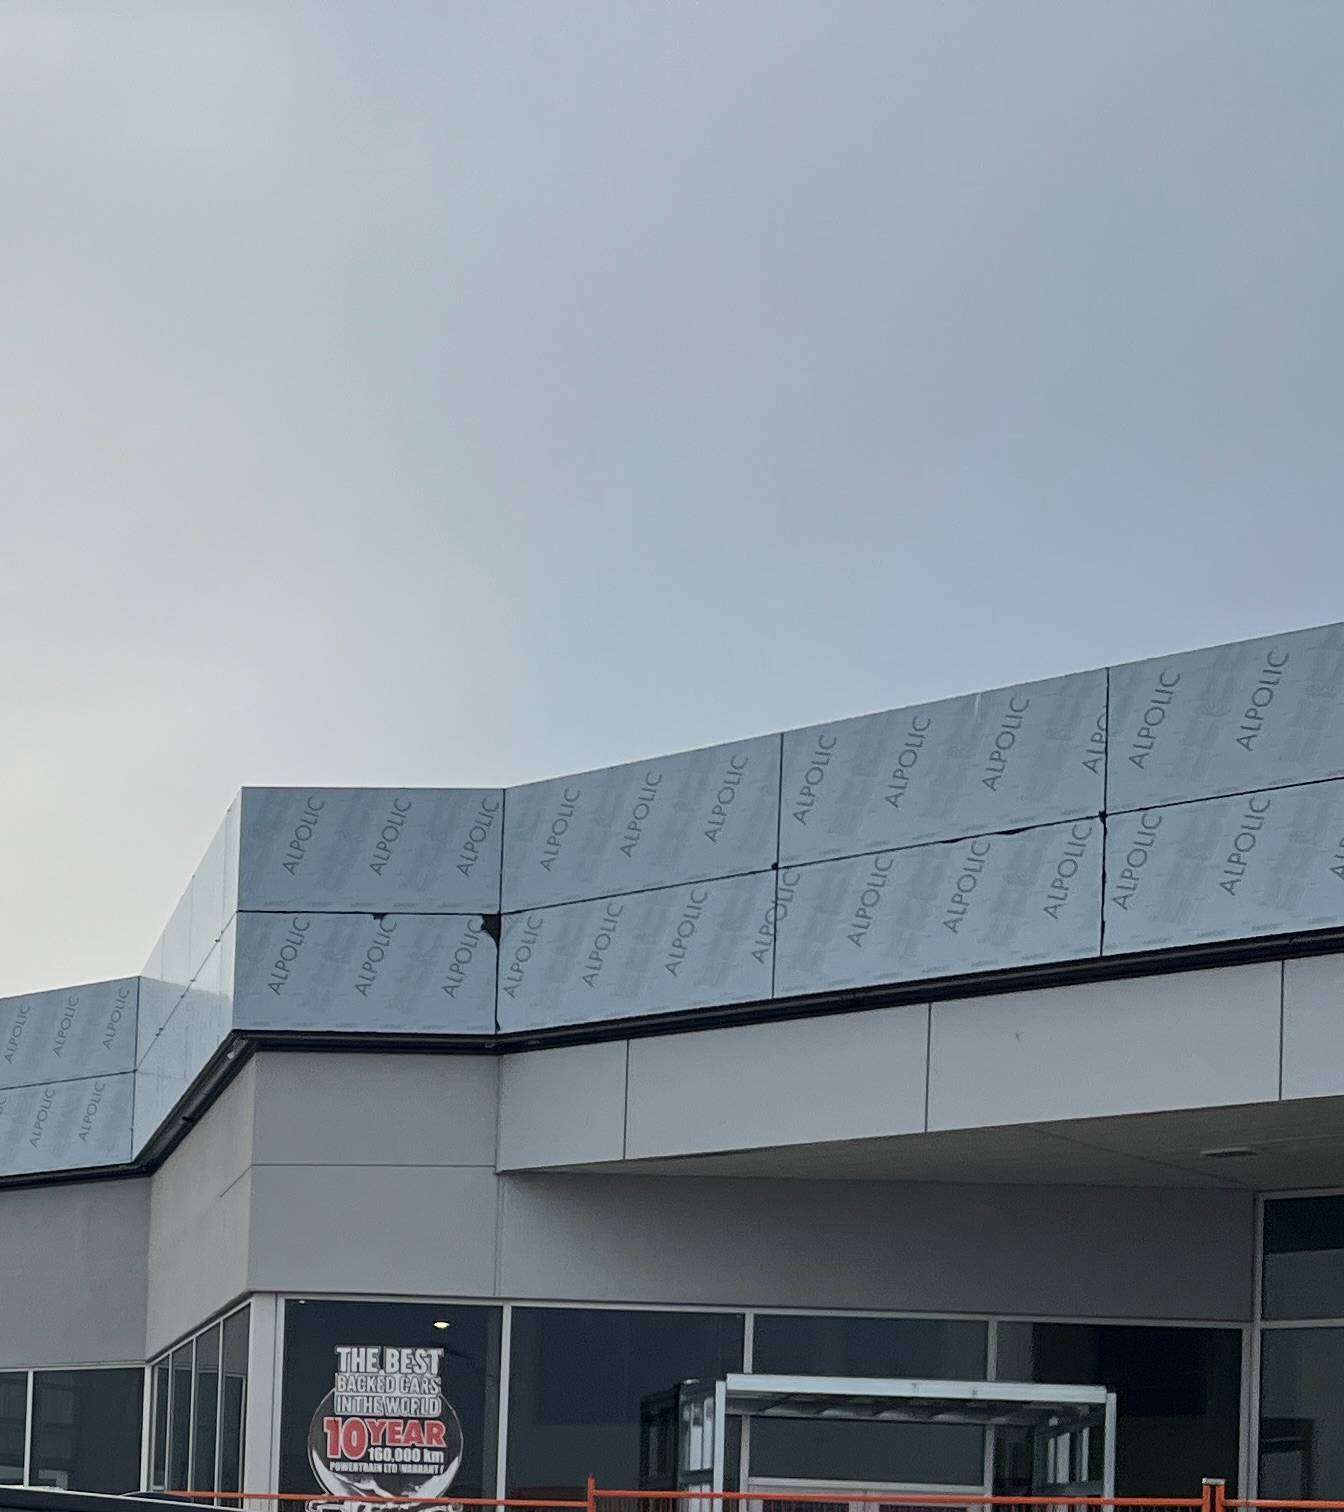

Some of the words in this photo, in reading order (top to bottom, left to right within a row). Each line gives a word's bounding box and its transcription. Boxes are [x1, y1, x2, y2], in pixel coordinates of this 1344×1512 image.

[1129, 670, 1181, 770] ALPOLIC
[1236, 650, 1290, 751] ALPOLIC
[792, 734, 838, 825] ALPOLIC
[885, 716, 931, 808] ALPOLIC
[982, 697, 1029, 792] ALPOLIC
[282, 797, 324, 877] ALPOLIC
[369, 797, 412, 877] ALPOLIC
[457, 797, 500, 878] ALPOLIC
[540, 787, 580, 872] ALPOLIC
[620, 771, 662, 858] ALPOLIC
[705, 753, 748, 844] ALPOLIC
[944, 839, 992, 934] ALPOLIC
[1043, 823, 1093, 920] ALPOLIC
[1111, 813, 1162, 911] ALPOLIC
[1219, 796, 1271, 896] ALPOLIC
[664, 889, 708, 977] ALPOLIC
[752, 872, 800, 964] ALPOLIC
[848, 856, 895, 948] ALPOLIC
[266, 917, 310, 996] ALPOLIC
[354, 919, 398, 998] ALPOLIC
[441, 918, 483, 999] ALPOLIC
[504, 916, 543, 1000] ALPOLIC
[582, 904, 623, 988] ALPOLIC
[5, 1005, 31, 1064] ALPOLIC
[53, 996, 79, 1057] ALPOLIC
[103, 988, 130, 1050] ALPOLIC
[31, 1088, 56, 1148] ALPOLIC
[79, 1082, 106, 1142] ALPOLIC
[336, 1347, 380, 1372] THE
[386, 1348, 444, 1375] BEST
[337, 1375, 396, 1393] BACKED
[399, 1376, 441, 1394] CARS
[324, 1417, 368, 1460] 10
[366, 1418, 446, 1448] YEAR
[386, 1397, 440, 1415] WORLD
[423, 1449, 444, 1463] km
